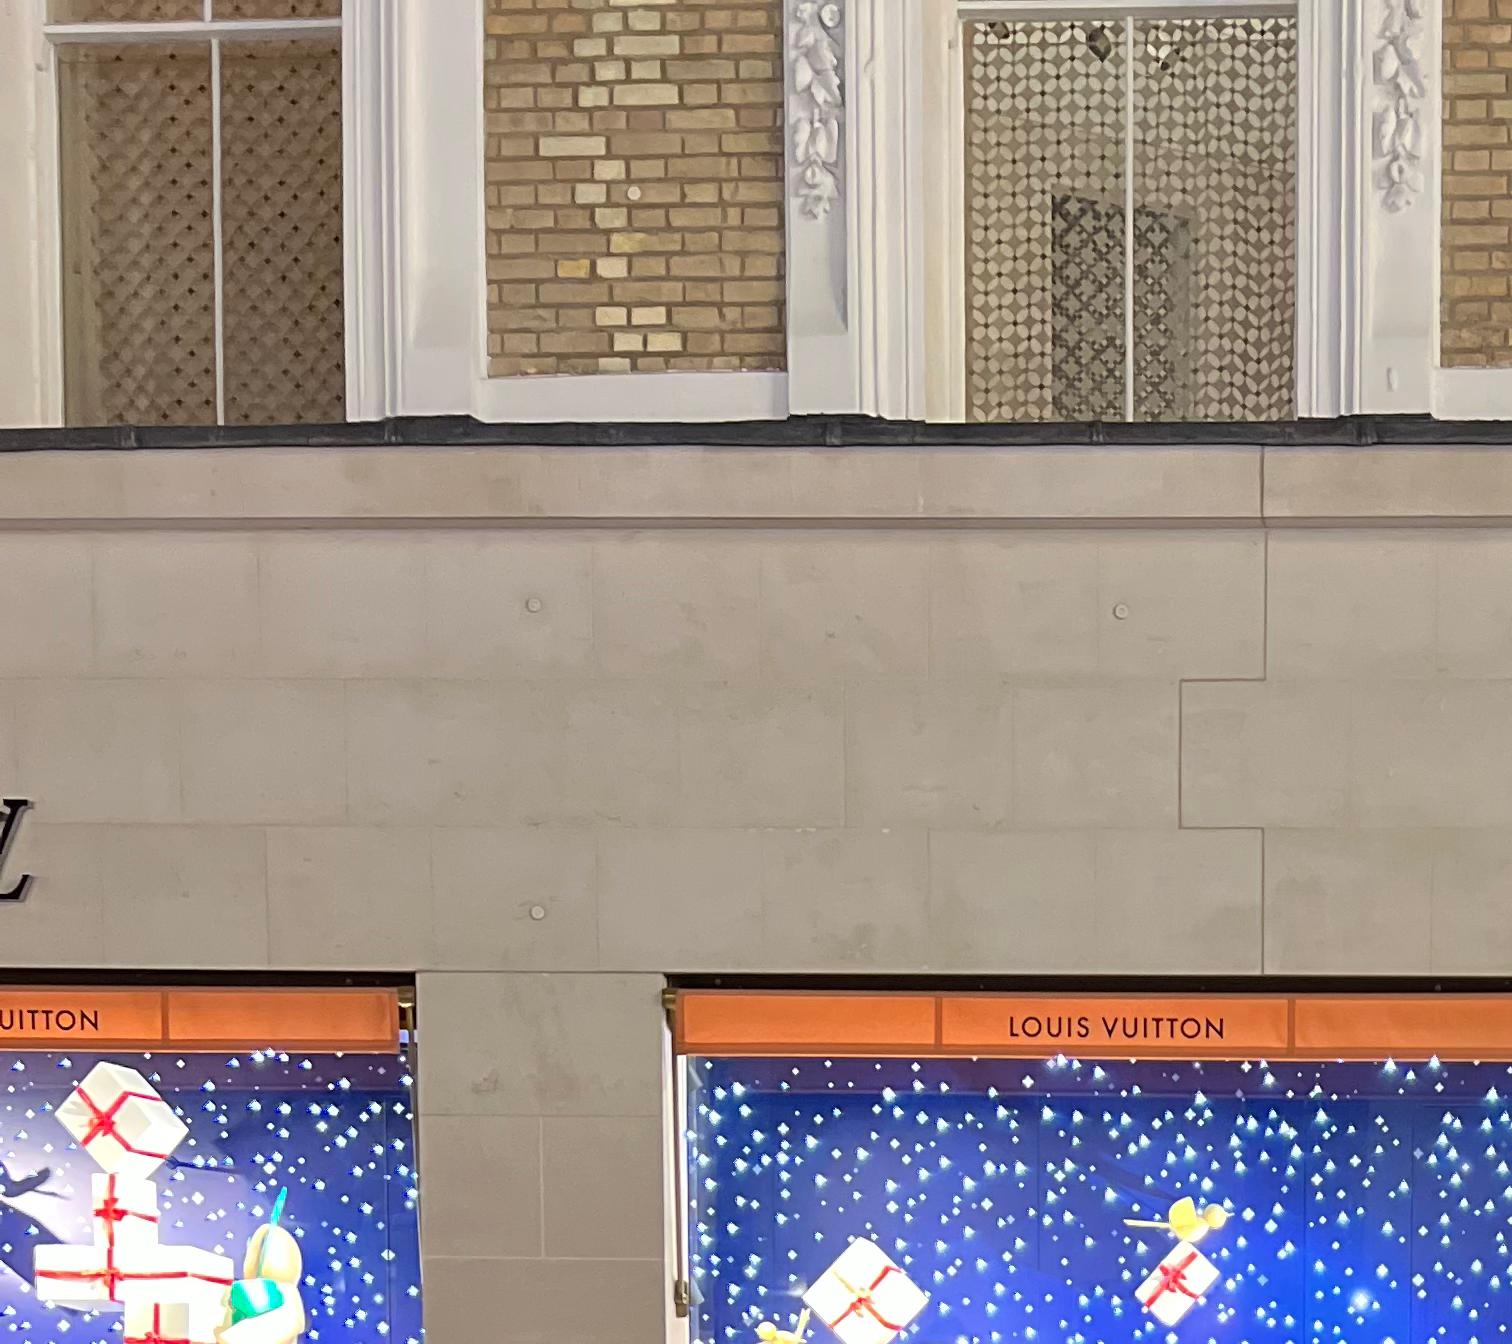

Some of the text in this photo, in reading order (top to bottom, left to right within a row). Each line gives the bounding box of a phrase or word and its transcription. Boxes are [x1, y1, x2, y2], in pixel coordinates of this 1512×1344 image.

[0, 1009, 98, 1030] UITTON
[1009, 1016, 1224, 1038] LOUIS VUITTON
